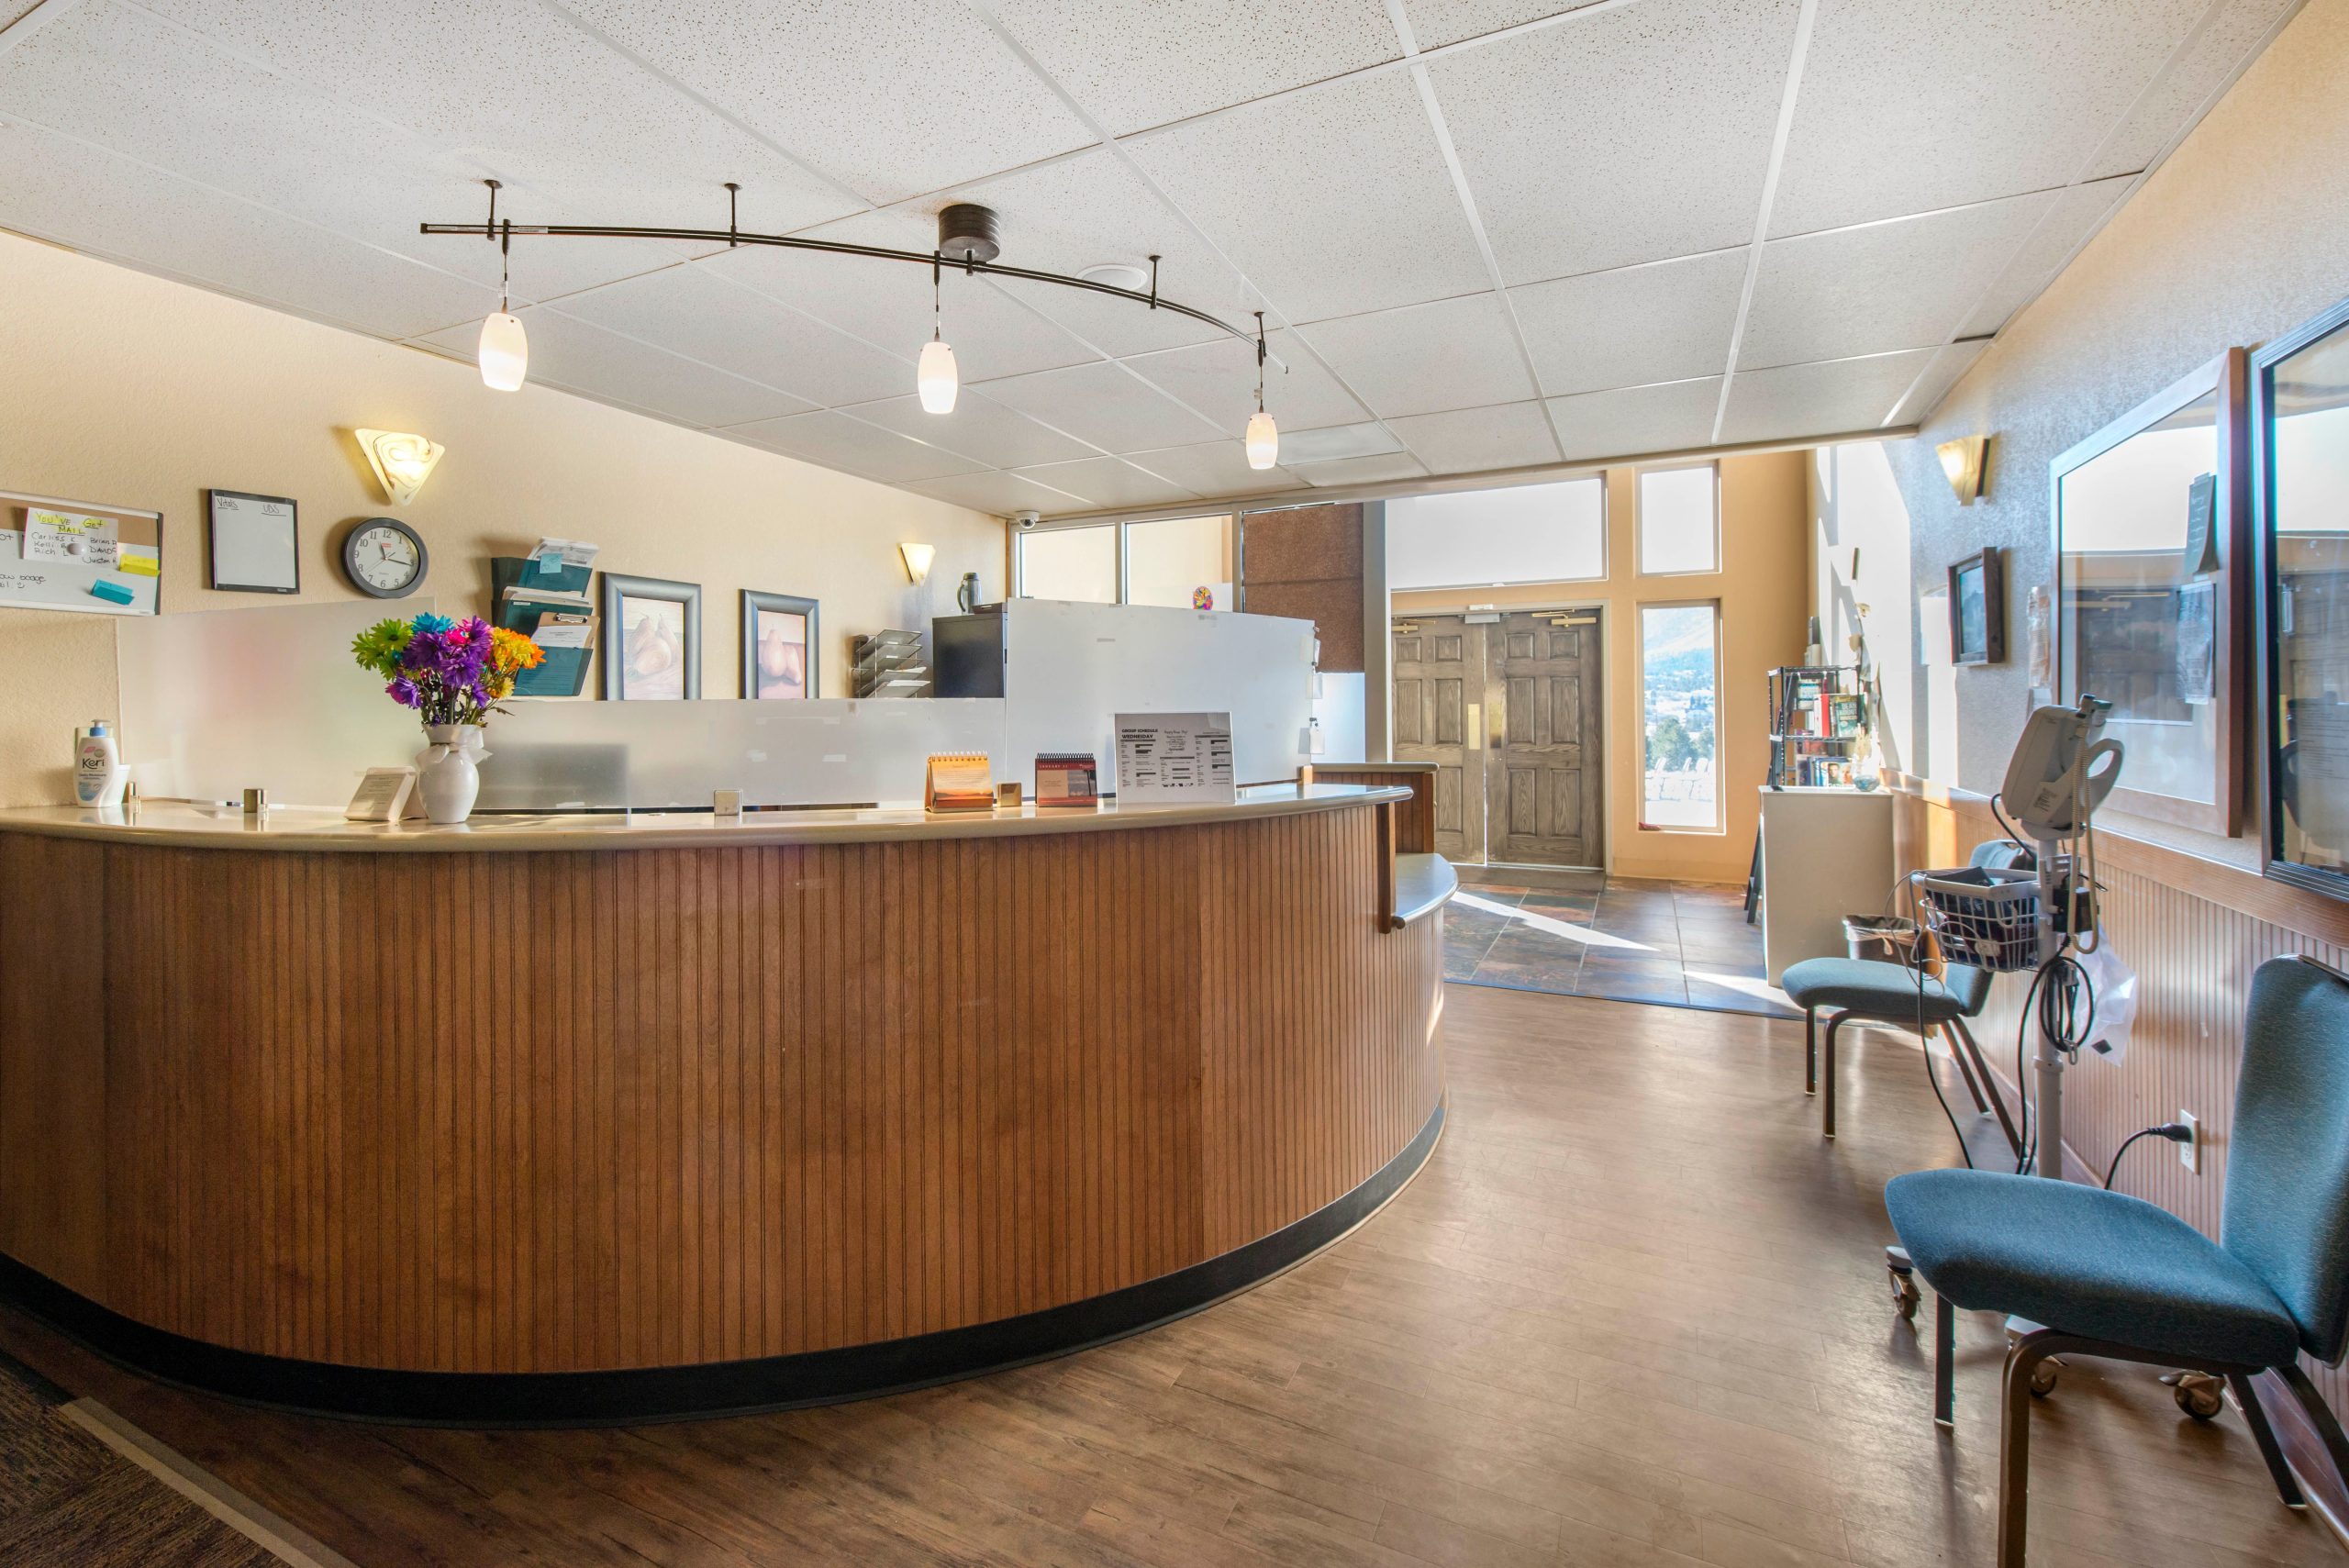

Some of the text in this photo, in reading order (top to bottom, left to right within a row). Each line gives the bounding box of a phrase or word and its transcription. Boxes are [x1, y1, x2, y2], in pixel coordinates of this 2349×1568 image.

[217, 496, 239, 508] Vitals
[59, 526, 85, 535] MAIL
[370, 530, 377, 540] 11
[383, 529, 392, 539] 12
[359, 538, 369, 548] 10
[398, 535, 403, 544] 1
[353, 550, 360, 559] 9
[406, 546, 412, 555] 2
[358, 563, 363, 573] 8
[368, 574, 373, 583] 7
[404, 571, 409, 579] 4
[380, 579, 386, 588] 6
[395, 578, 399, 587] 5
[83, 758, 105, 770] Keri
